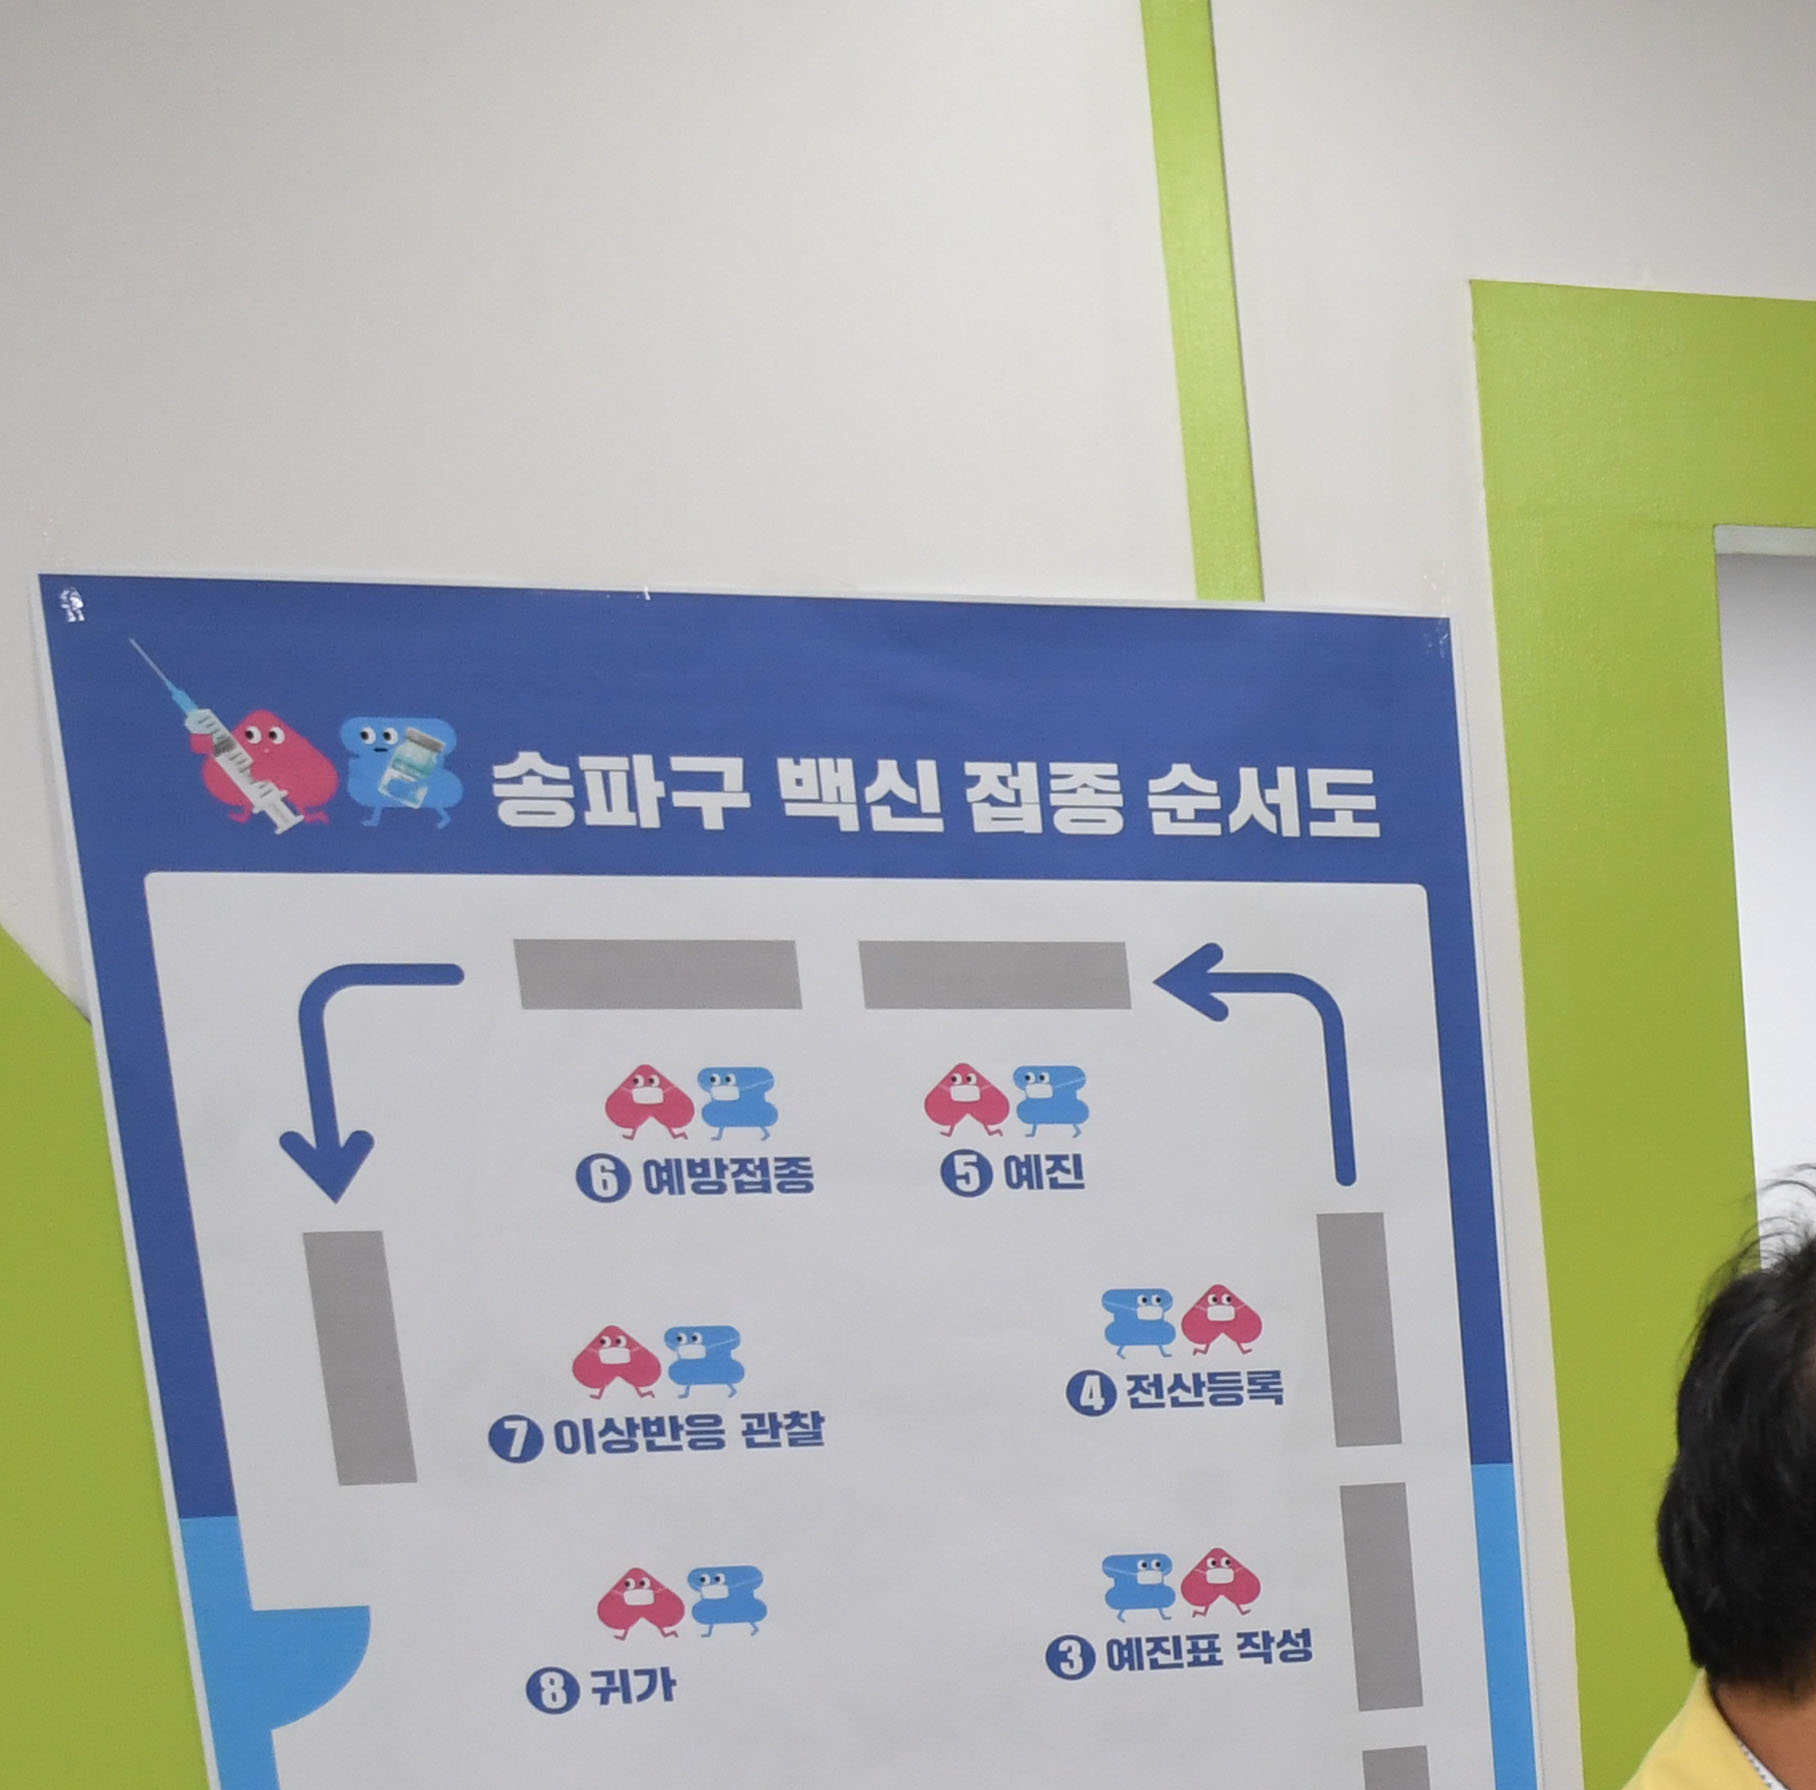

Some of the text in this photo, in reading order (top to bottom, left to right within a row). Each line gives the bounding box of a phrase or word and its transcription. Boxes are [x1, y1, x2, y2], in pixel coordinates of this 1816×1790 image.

[492, 750, 1382, 842] 송파구 백신 접종 순서도
[641, 1154, 816, 1198] 예방접종
[1003, 1151, 1086, 1194] 예진
[1124, 1369, 1286, 1411] 전산등록
[552, 1413, 729, 1457] 이상반응
[739, 1408, 826, 1451] 관찰
[1105, 1632, 1224, 1674] 예진표
[1237, 1627, 1314, 1670] 작성
[589, 1666, 678, 1706] 귀가
